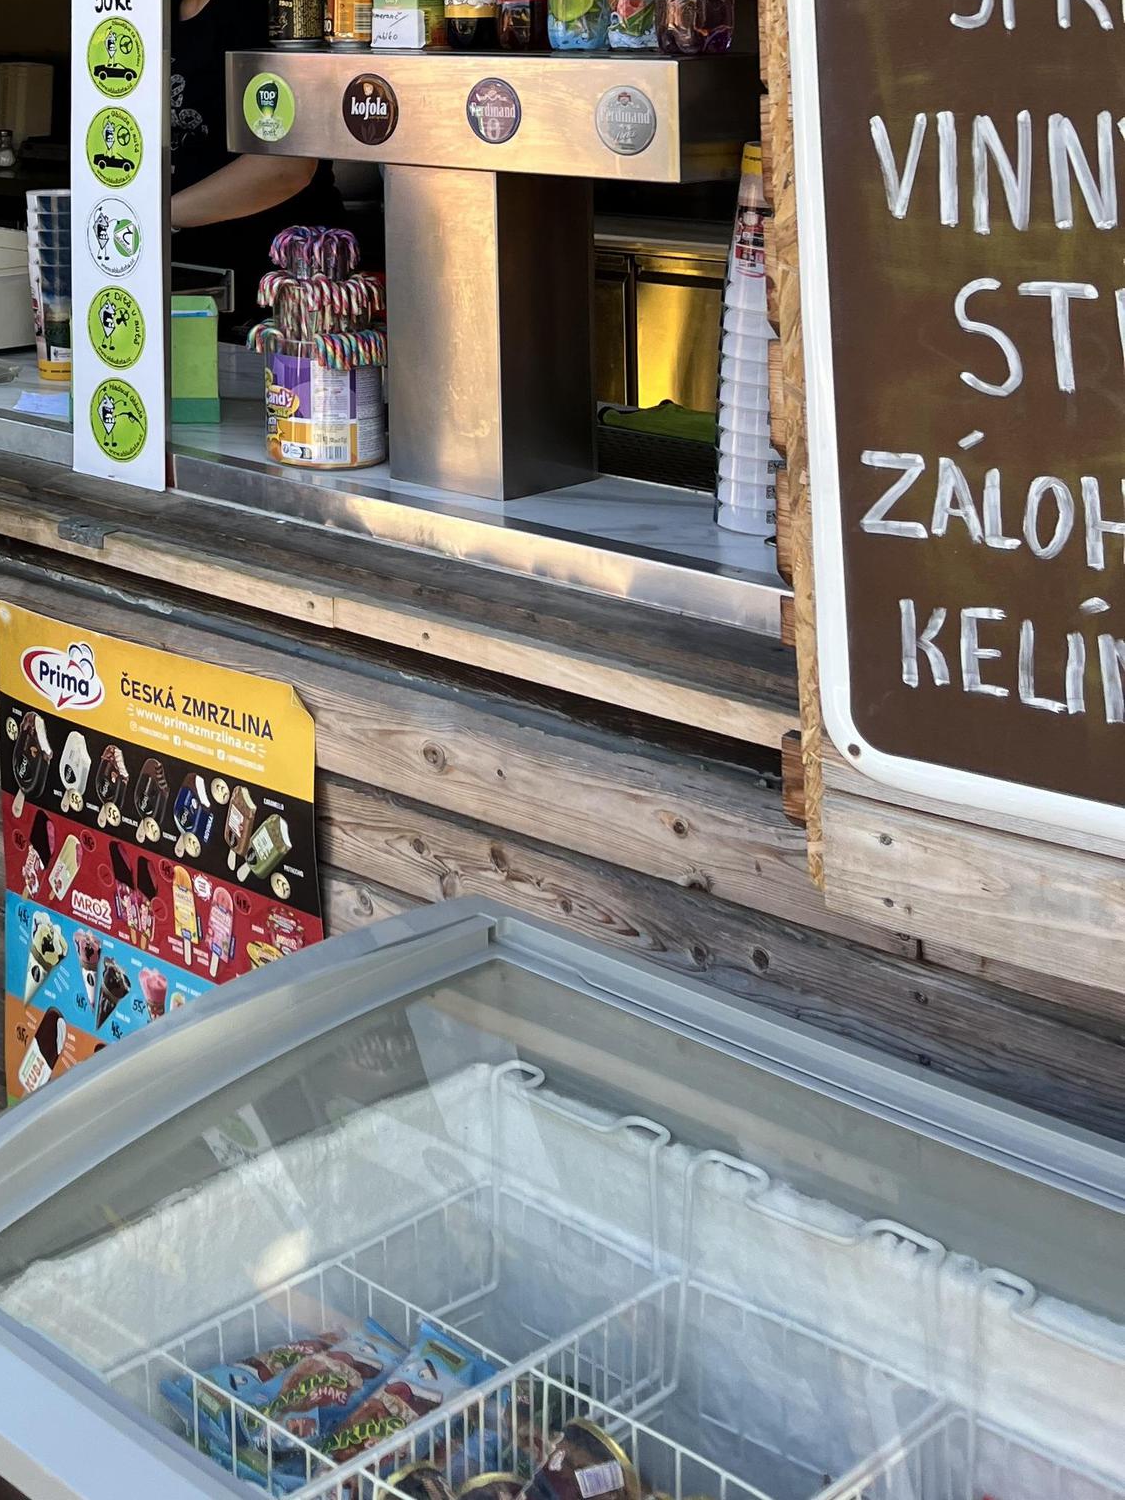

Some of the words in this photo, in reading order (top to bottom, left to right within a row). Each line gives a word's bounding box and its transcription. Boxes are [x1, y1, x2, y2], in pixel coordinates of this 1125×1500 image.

[259, 91, 275, 100] TOP
[351, 97, 388, 120] kofola
[471, 102, 516, 119] Ferdinand
[601, 107, 650, 124] Ferdinand
[955, 277, 1125, 398] ST
[39, 660, 89, 697] Prima
[121, 672, 175, 711] ČESKÁ
[182, 695, 273, 741] ZMRZLINA
[135, 707, 256, 753] www.primazmrzlina.cz
